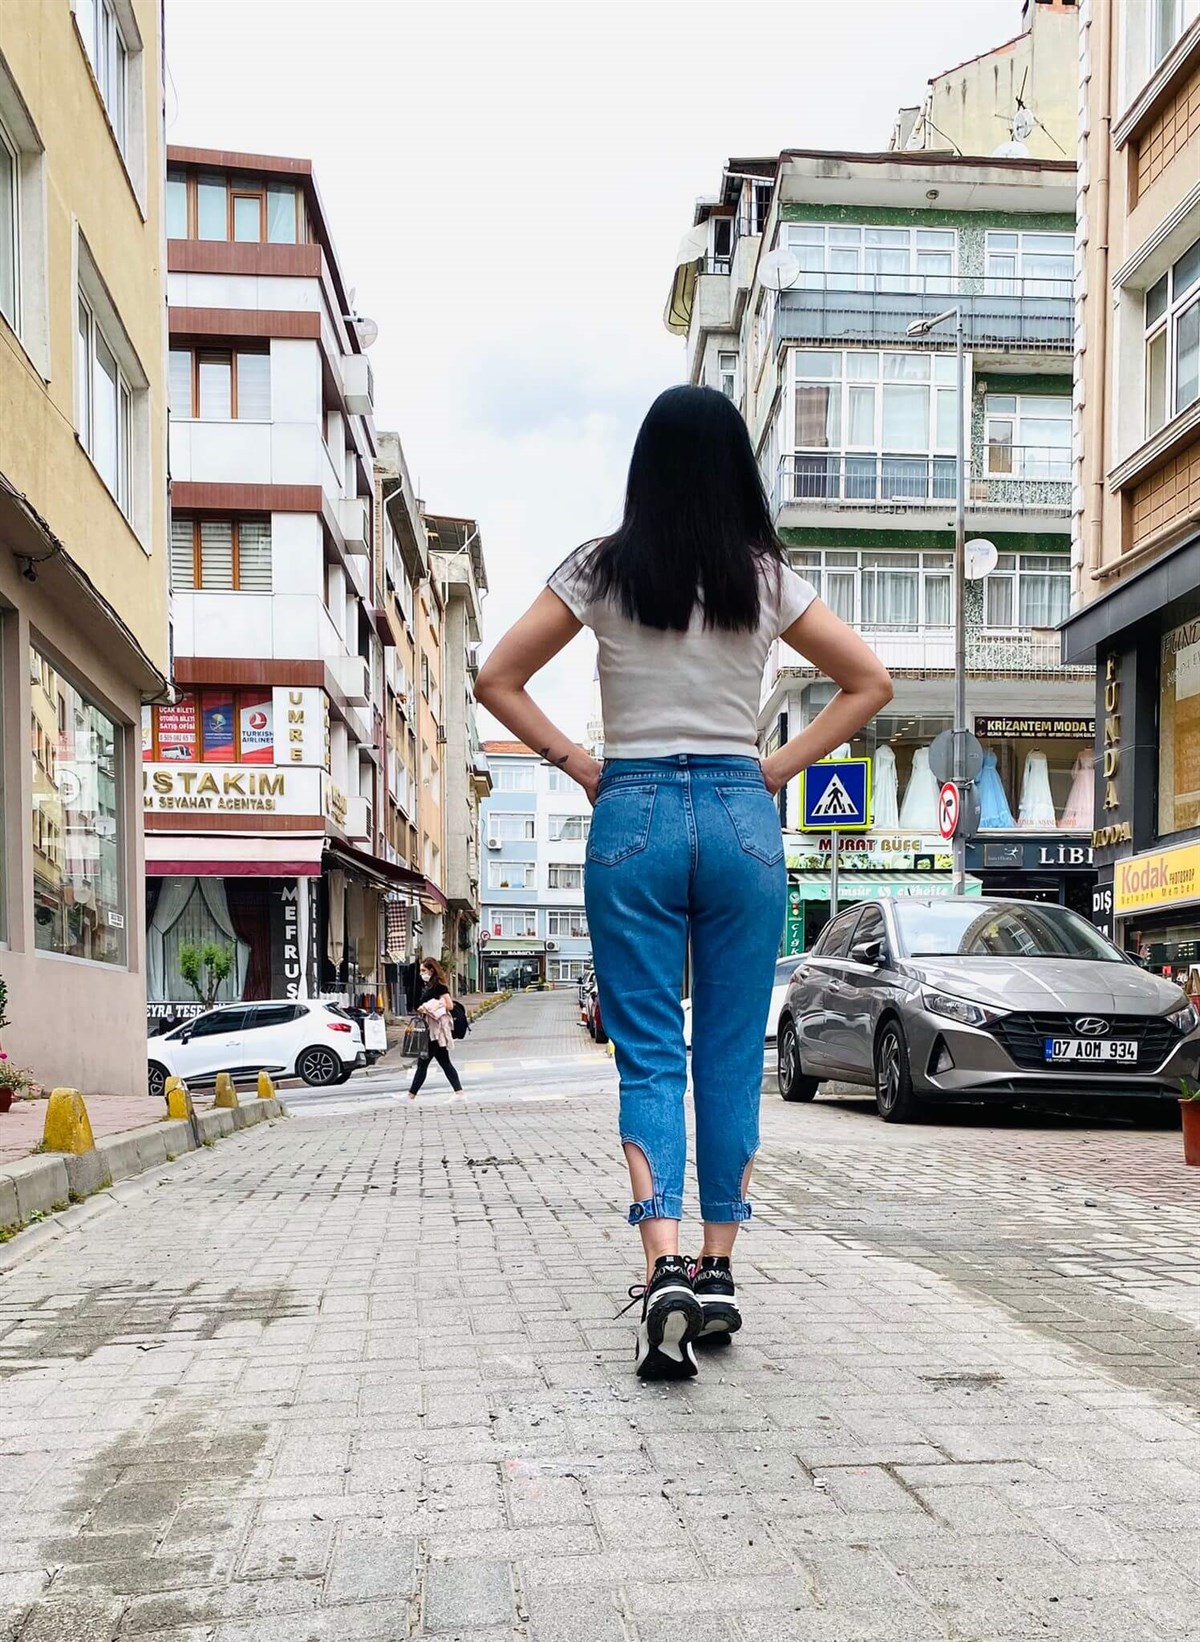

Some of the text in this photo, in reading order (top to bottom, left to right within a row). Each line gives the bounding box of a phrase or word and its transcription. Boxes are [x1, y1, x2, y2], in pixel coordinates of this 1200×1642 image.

[288, 691, 305, 761] UMRE
[987, 718, 1052, 731] KRİZANTEM
[1054, 721, 1087, 732] MODA
[1103, 656, 1122, 811] FUNDA
[159, 796, 213, 809] SEYAHAT
[818, 836, 921, 851] MURAT BÜFE
[1122, 858, 1168, 894] Kodak
[1092, 890, 1112, 915] DIŞ
[1121, 884, 1195, 905] Network Member
[175, 1004, 206, 1018] TESE
[1053, 1041, 1135, 1059] 07 AOM 934
